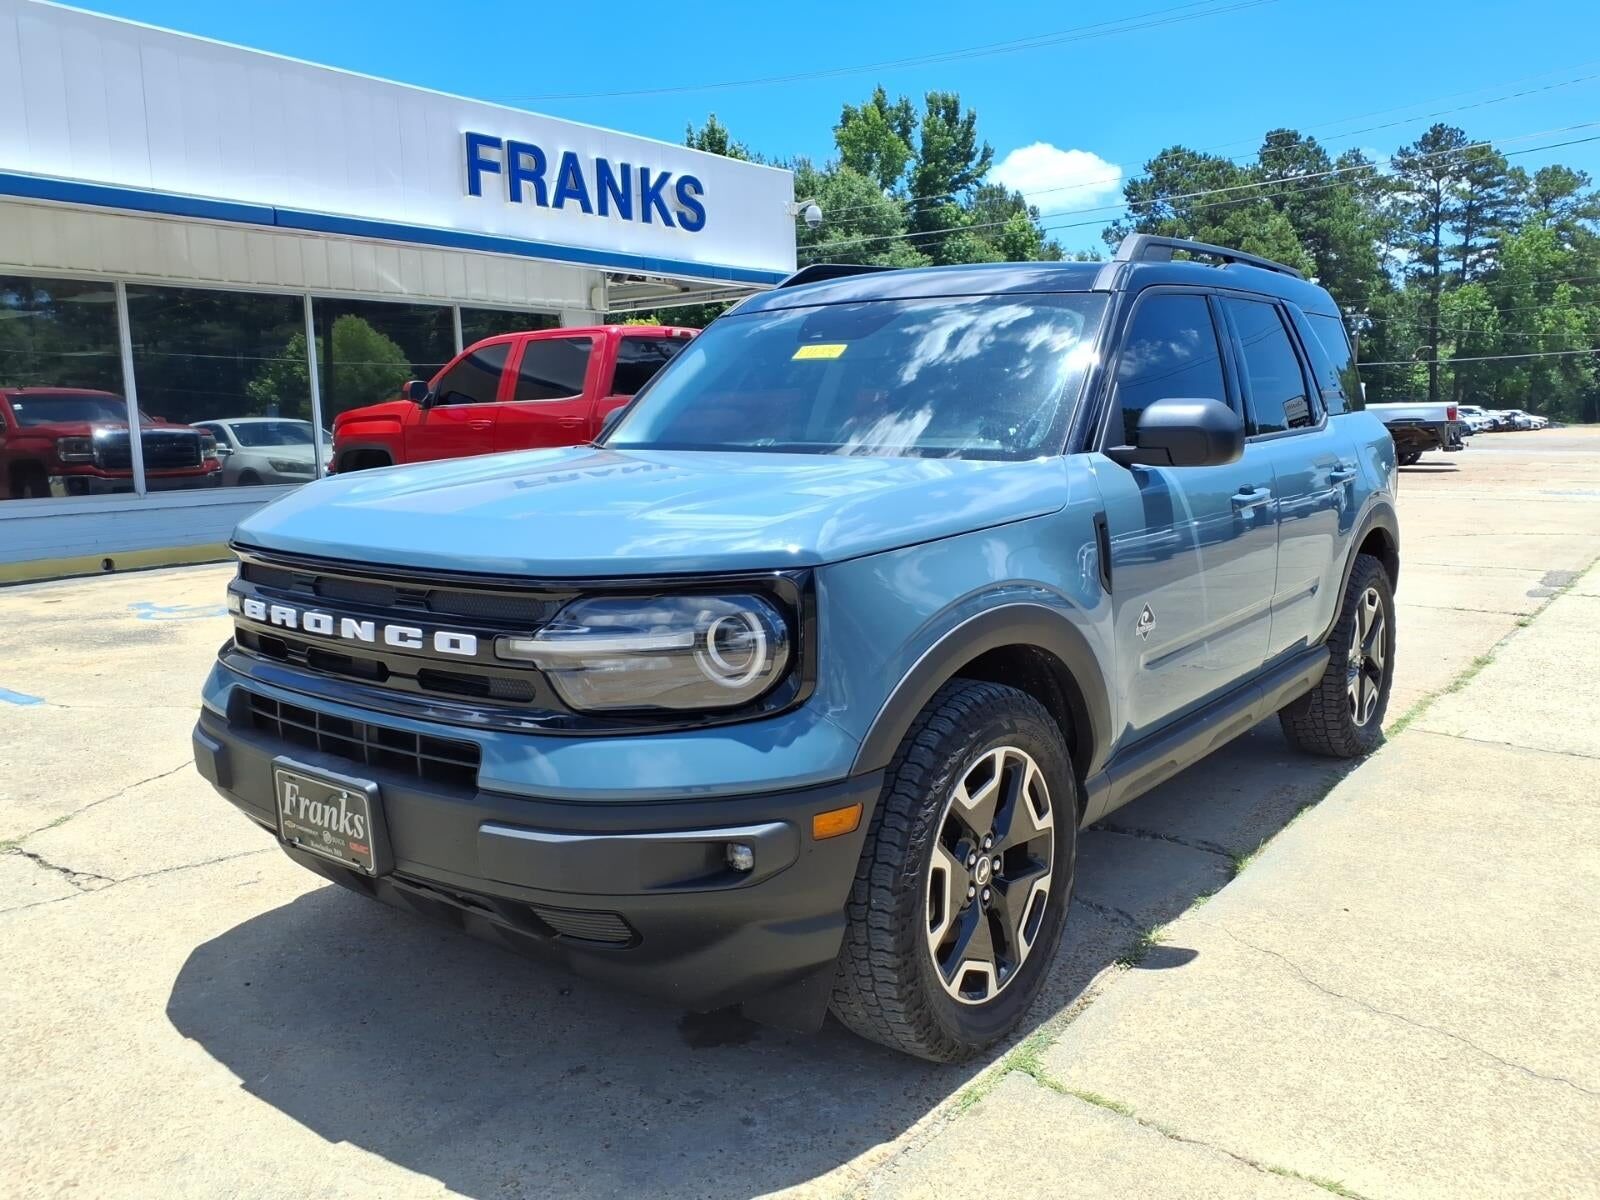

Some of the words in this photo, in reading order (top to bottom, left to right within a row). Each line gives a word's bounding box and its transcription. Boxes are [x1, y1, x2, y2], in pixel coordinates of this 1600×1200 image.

[465, 131, 706, 232] FRANKS
[244, 599, 478, 656] BRONCO
[283, 781, 364, 839] Franks
